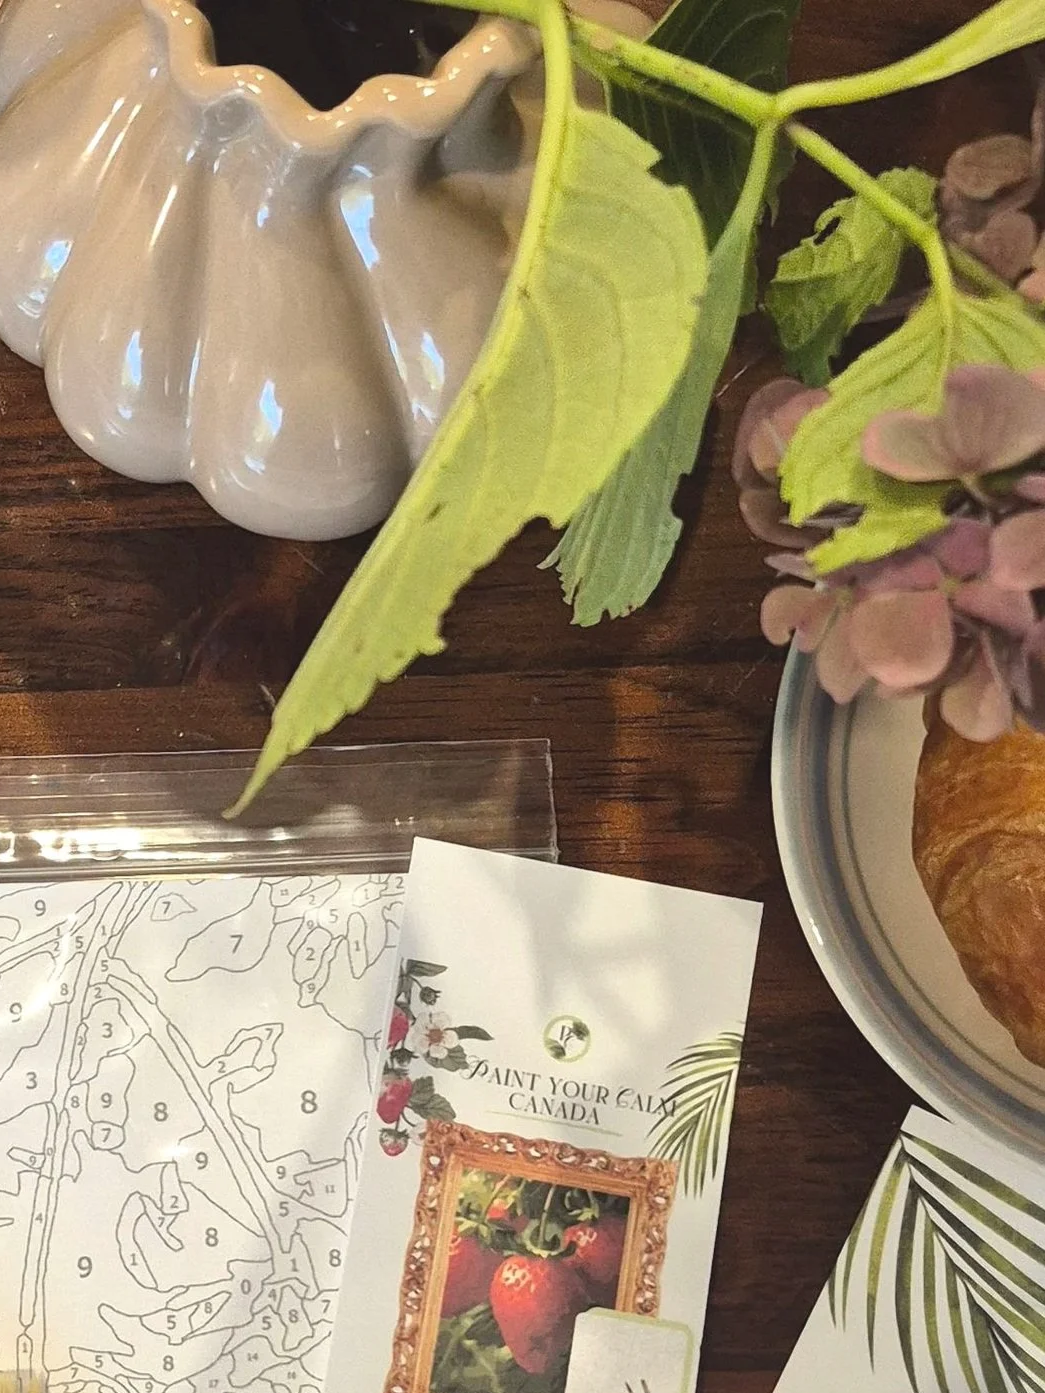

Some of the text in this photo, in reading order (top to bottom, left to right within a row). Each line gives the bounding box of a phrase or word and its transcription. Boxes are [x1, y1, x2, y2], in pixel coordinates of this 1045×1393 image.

[35, 901, 46, 916] 9
[163, 902, 170, 914] 7
[330, 910, 338, 923] 5
[76, 936, 83, 949] 5
[231, 936, 242, 953] 7
[306, 948, 315, 960] 2
[101, 960, 108, 972] 5
[95, 988, 102, 998] 2
[308, 983, 315, 993] 9
[102, 1024, 112, 1038] 3
[218, 1062, 225, 1072] 2
[26, 1072, 37, 1089] 3
[460, 1055, 543, 1091] PAINT
[549, 1077, 609, 1106] YOUR
[102, 1093, 111, 1107] 9
[301, 1091, 316, 1113] 8
[154, 1102, 168, 1121] 8
[509, 1094, 600, 1125] CANADA
[102, 1129, 111, 1141] 7
[196, 1153, 207, 1169] 9
[277, 1166, 285, 1179] 9
[170, 1196, 179, 1208] 2
[279, 1201, 289, 1217] 5
[205, 1227, 218, 1246] 8
[130, 1254, 137, 1265] 1
[329, 1249, 341, 1267] 8
[77, 1256, 92, 1278] 9
[291, 1259, 299, 1271] 1
[241, 1280, 251, 1294] 0
[322, 1300, 330, 1312] 7
[167, 1315, 176, 1329] 5
[262, 1316, 272, 1330] 5
[289, 1310, 298, 1323] 8
[95, 1355, 103, 1367] 5
[163, 1356, 174, 1371] 8
[71, 1367, 78, 1379] 7
[145, 1382, 153, 1393] 9
